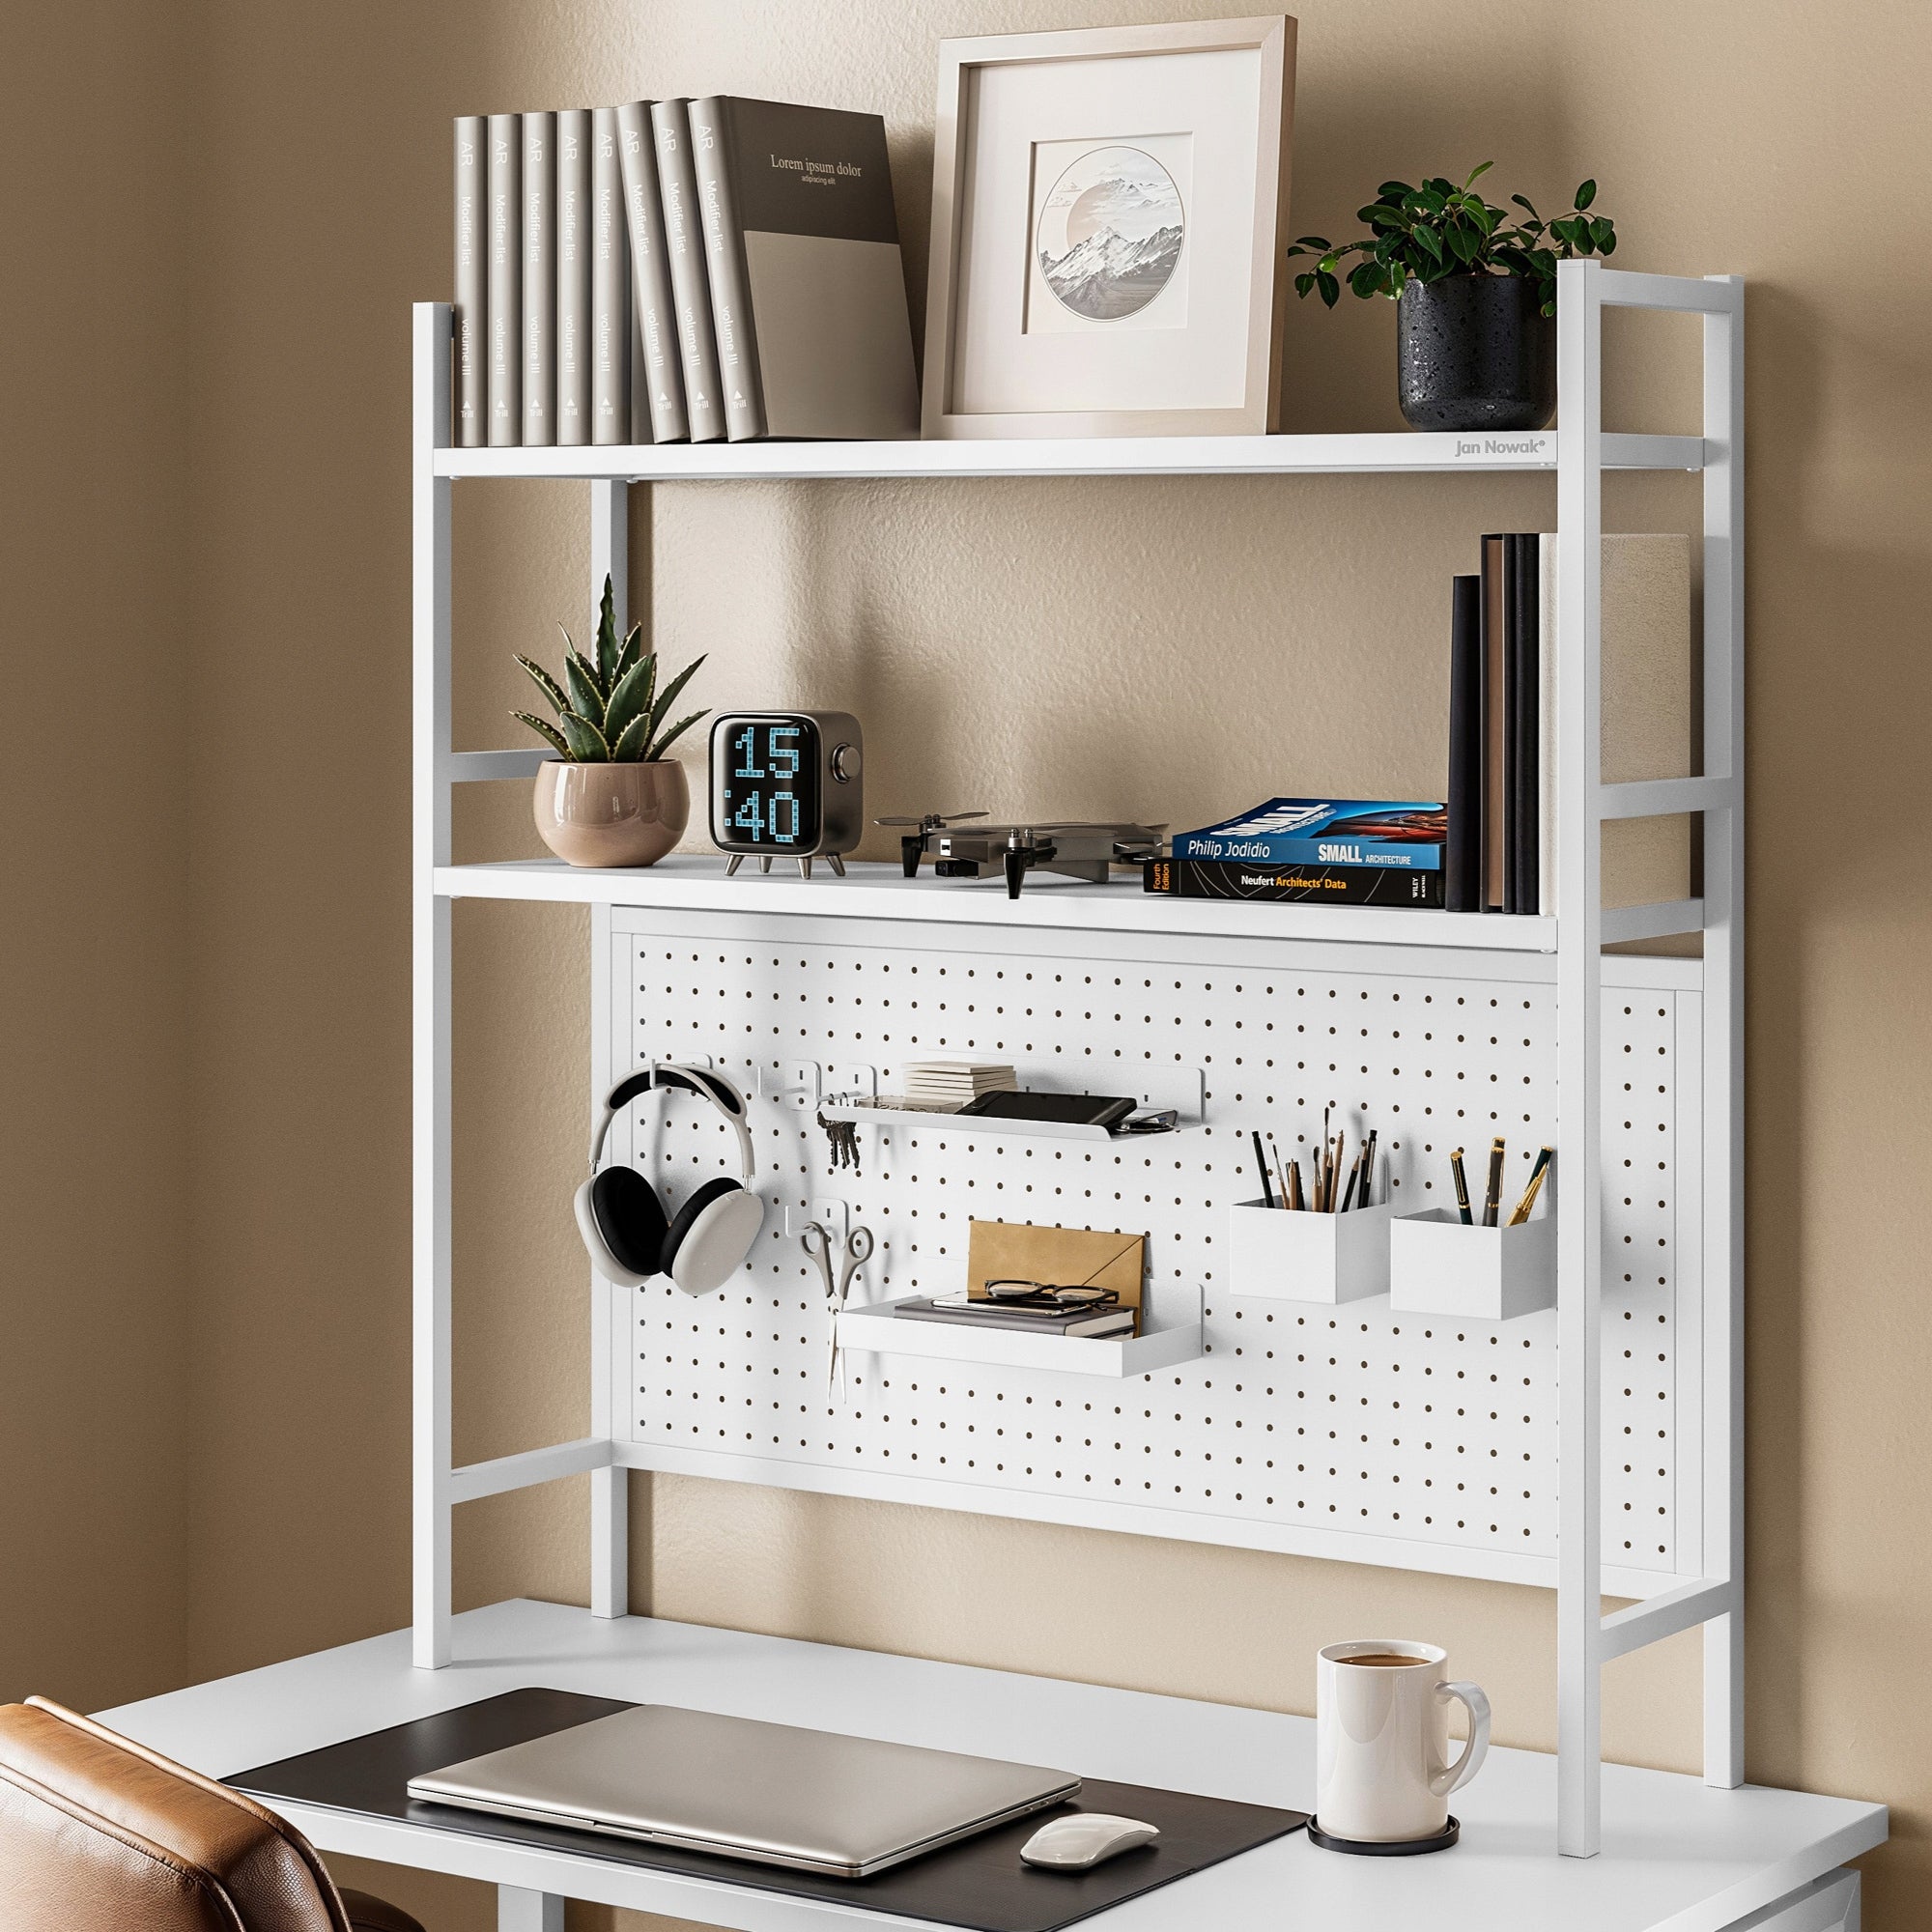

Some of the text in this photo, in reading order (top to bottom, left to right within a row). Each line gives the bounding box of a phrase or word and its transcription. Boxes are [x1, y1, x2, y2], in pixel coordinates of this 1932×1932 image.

[461, 142, 473, 166] AR
[495, 139, 508, 164] AR
[529, 137, 543, 162] AR
[564, 135, 577, 160] AR
[600, 133, 612, 158] AR
[626, 129, 639, 155] AR
[662, 128, 676, 153] AR
[698, 126, 713, 151] AR
[771, 154, 863, 177] Lorem ipsum dolor
[462, 196, 471, 266] Modifier list
[496, 195, 506, 265] Modifier list
[530, 193, 541, 263] Modifier list
[564, 191, 576, 262] Modifier list
[601, 189, 611, 260] Modifier list
[633, 185, 649, 255] Modifier list
[668, 182, 688, 255] Modifier list
[705, 180, 724, 253] Modifier list
[462, 319, 471, 361] volume
[496, 317, 506, 361] volume
[531, 316, 541, 359] volume
[565, 315, 576, 359] volume
[600, 313, 611, 357] volume
[647, 309, 661, 354] volume
[684, 307, 697, 353] volume
[722, 305, 734, 352] volume
[1455, 440, 1481, 457] Jan
[735, 726, 800, 779] 15
[1209, 804, 1331, 837] SMALL
[1188, 839, 1270, 860] Philip Jodidio
[1318, 844, 1411, 866] SMALL ARCHITECTURE
[1240, 875, 1274, 887] Neufert
[1324, 879, 1347, 889] Data
